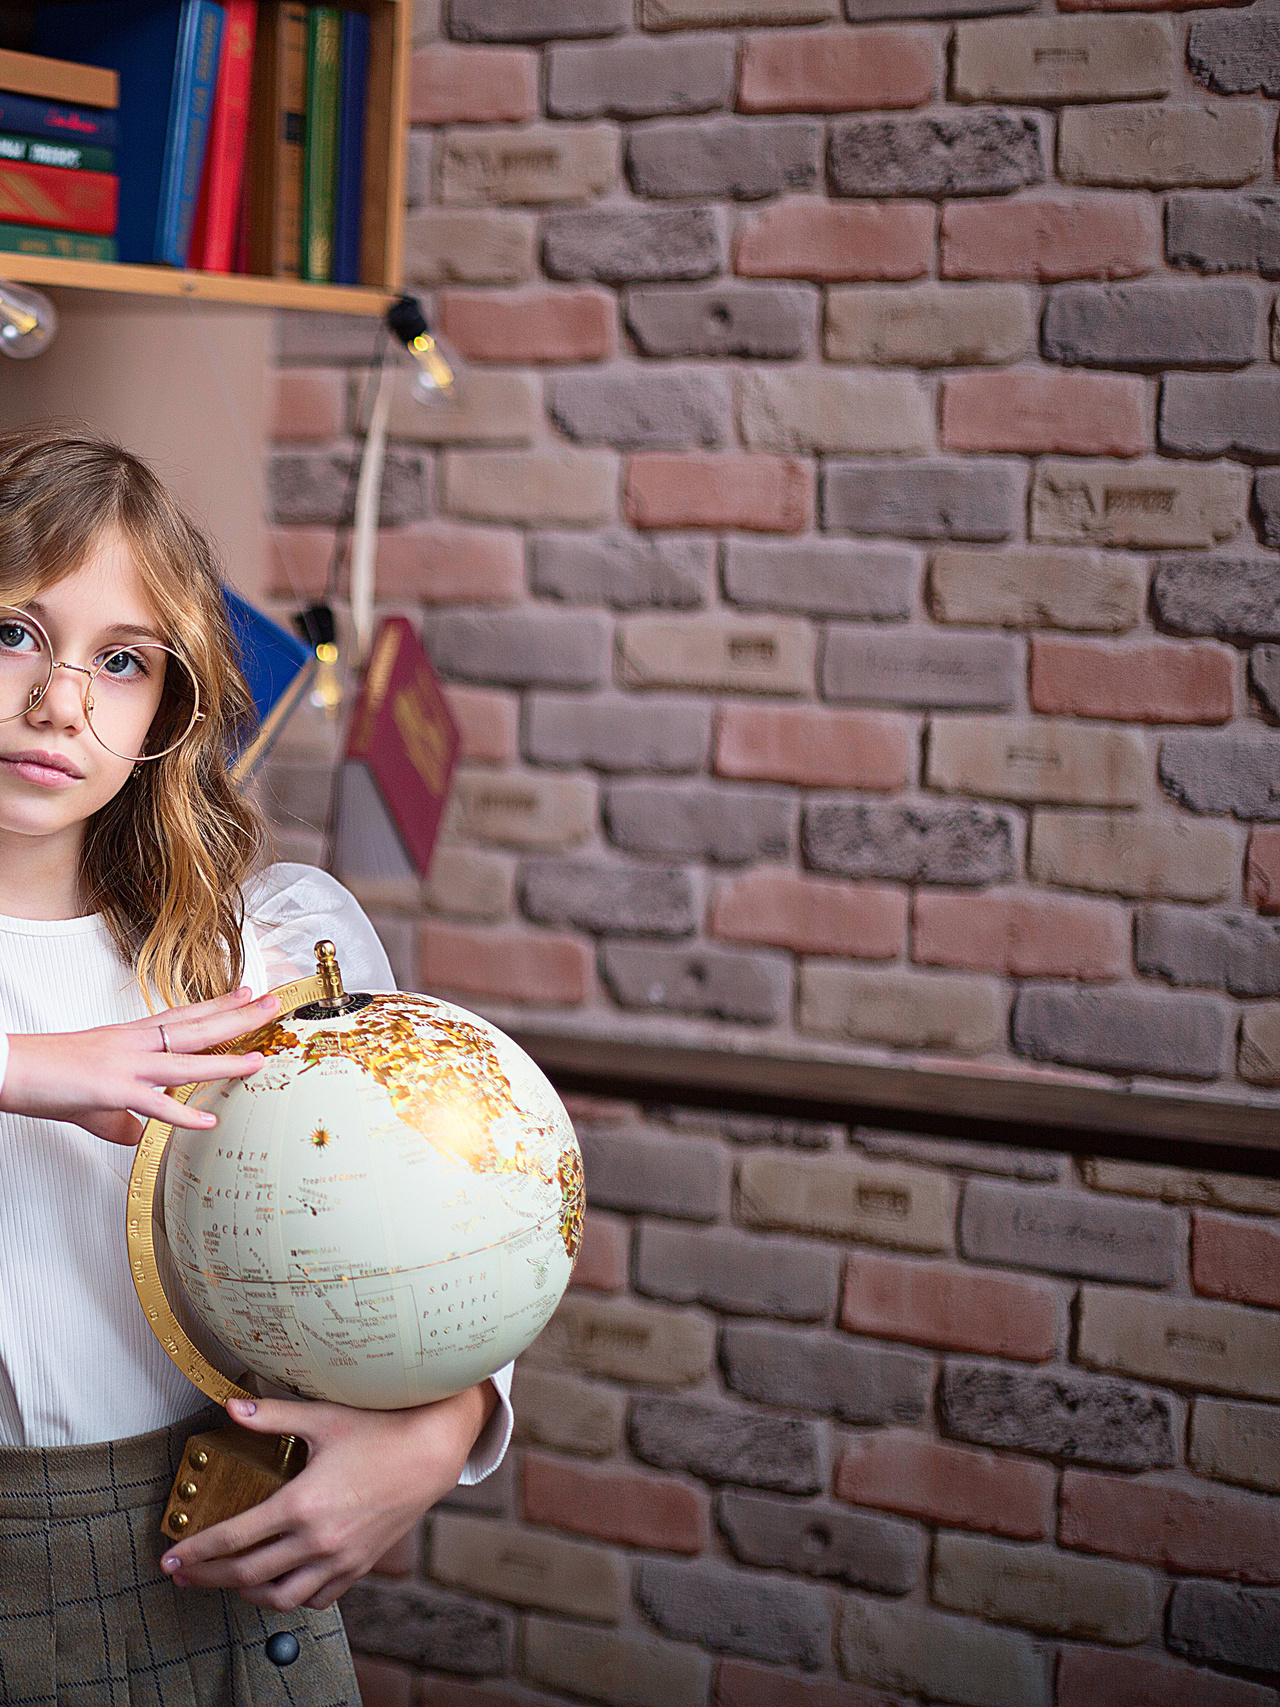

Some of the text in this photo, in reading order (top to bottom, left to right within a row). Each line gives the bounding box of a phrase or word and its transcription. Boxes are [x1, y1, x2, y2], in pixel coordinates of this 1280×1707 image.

[216, 1148, 268, 1161] NORTH
[207, 1186, 274, 1200] PACIFIC
[212, 1223, 263, 1236] OCEAN
[429, 1272, 486, 1294] SOUTH
[423, 1290, 499, 1319] PACIFIC
[430, 1314, 488, 1338] OCEAN
